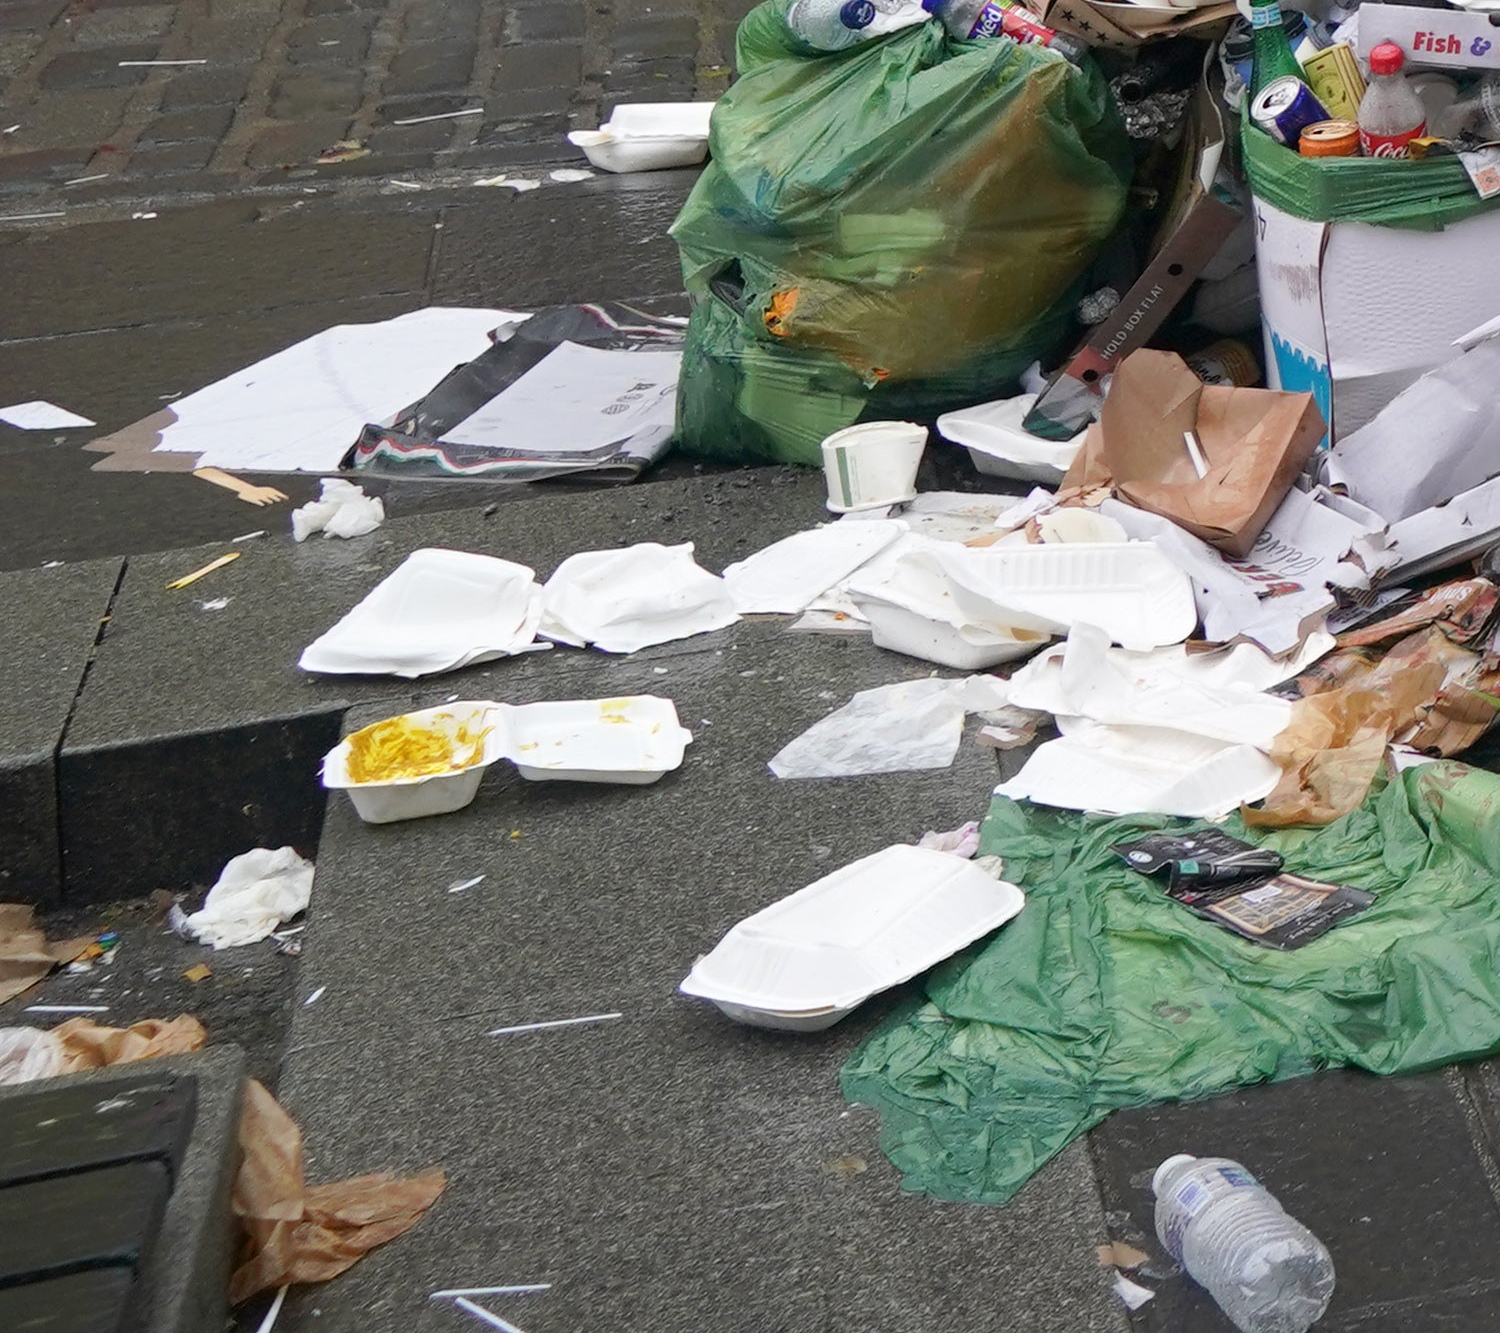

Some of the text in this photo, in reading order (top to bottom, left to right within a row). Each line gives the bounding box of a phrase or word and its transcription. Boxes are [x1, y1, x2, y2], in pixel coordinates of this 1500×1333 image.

[1412, 30, 1463, 56] Fish
[1470, 35, 1491, 58] &
[1101, 285, 1165, 361] HOLD BOX FLAT
